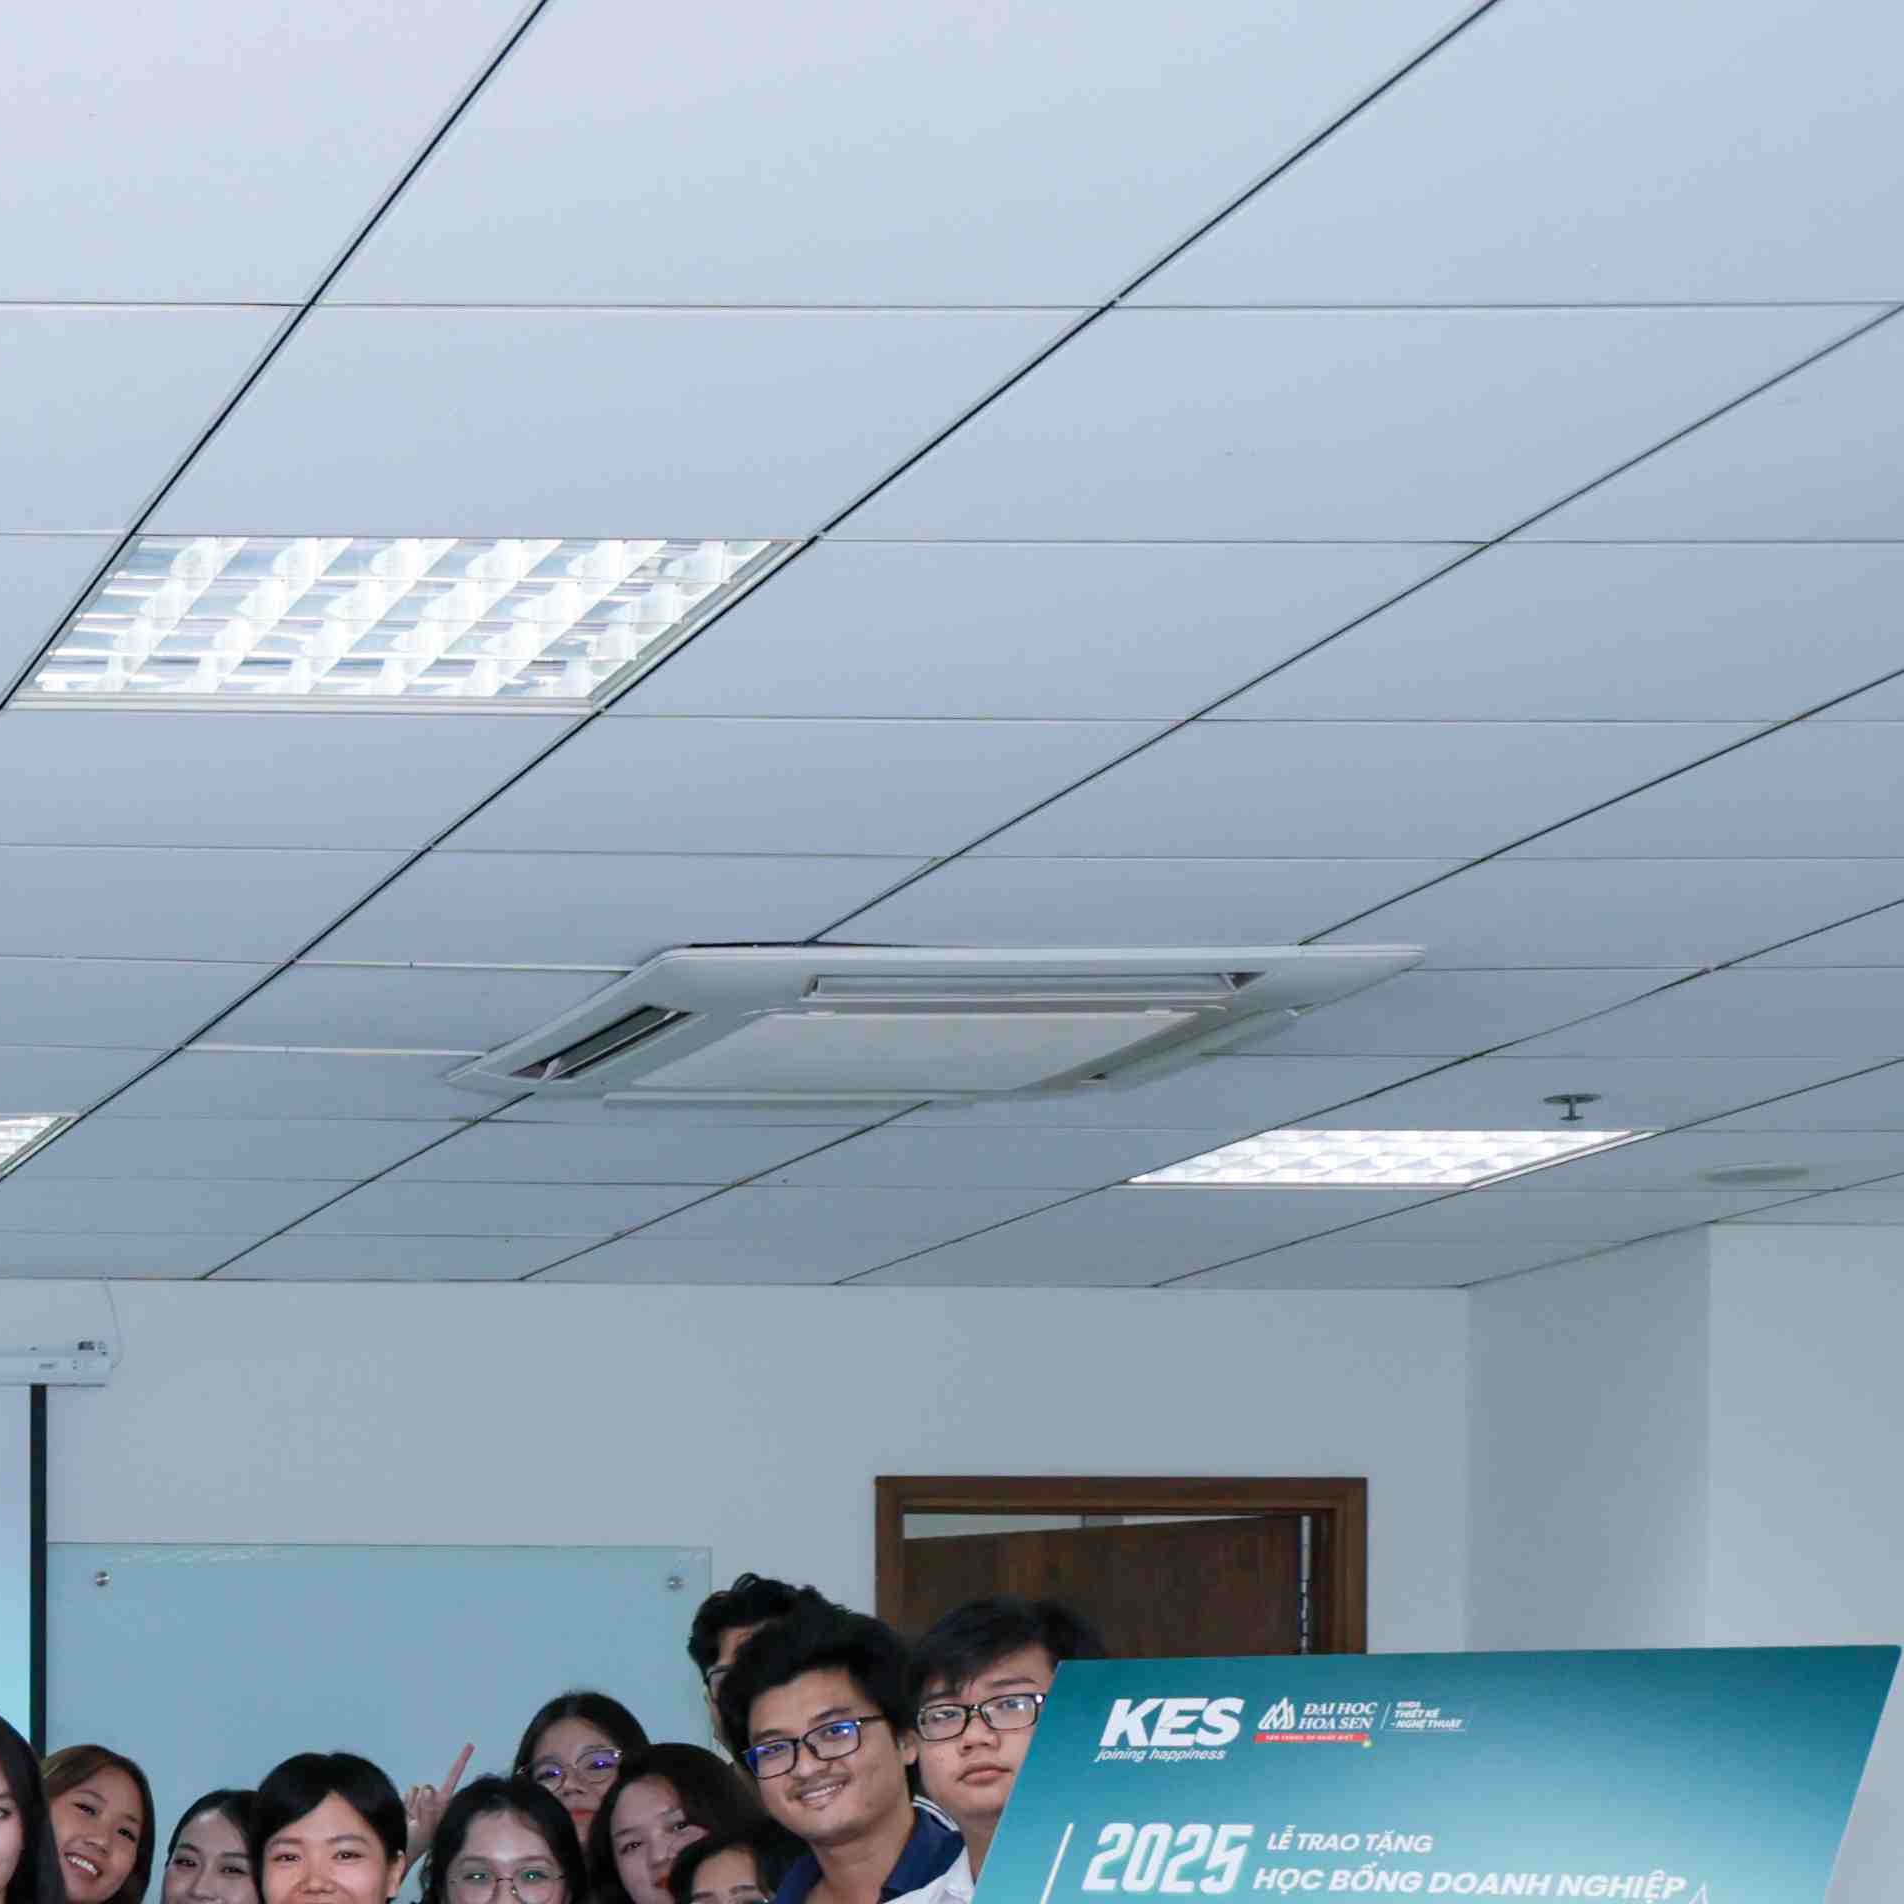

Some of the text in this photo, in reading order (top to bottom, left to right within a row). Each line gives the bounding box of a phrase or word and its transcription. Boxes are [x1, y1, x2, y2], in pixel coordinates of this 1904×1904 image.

[1098, 1698, 1245, 1747] KES
[1298, 1717, 1374, 1730] HOA SEN
[1095, 1748, 1226, 1763] joining happiness
[1081, 1822, 1255, 1893] 2025
[1266, 1824, 1433, 1858] LỄ TRAO TẶNG
[1253, 1860, 1687, 1904] HỌC BỔNG DOANH NGHIỆP
